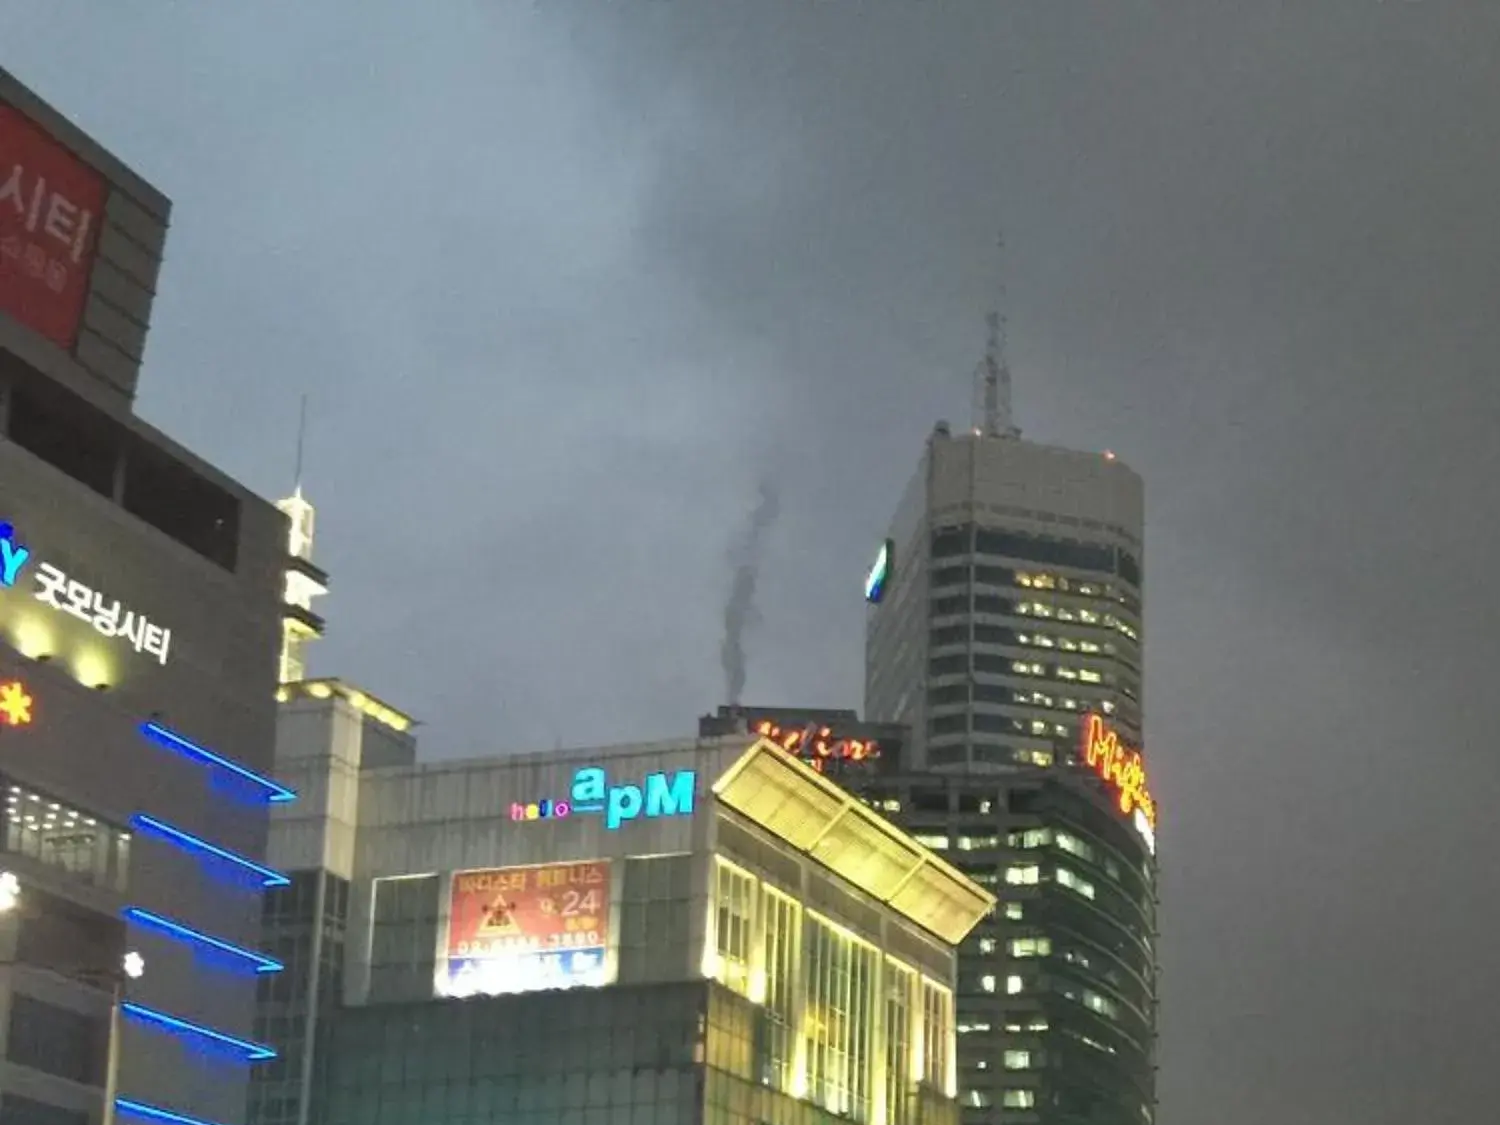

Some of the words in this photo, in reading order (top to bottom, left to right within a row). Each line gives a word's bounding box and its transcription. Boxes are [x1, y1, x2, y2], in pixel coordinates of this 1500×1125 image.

[34, 561, 171, 665] 굿모닝시티
[571, 767, 695, 830] apM
[561, 889, 602, 917] 24
